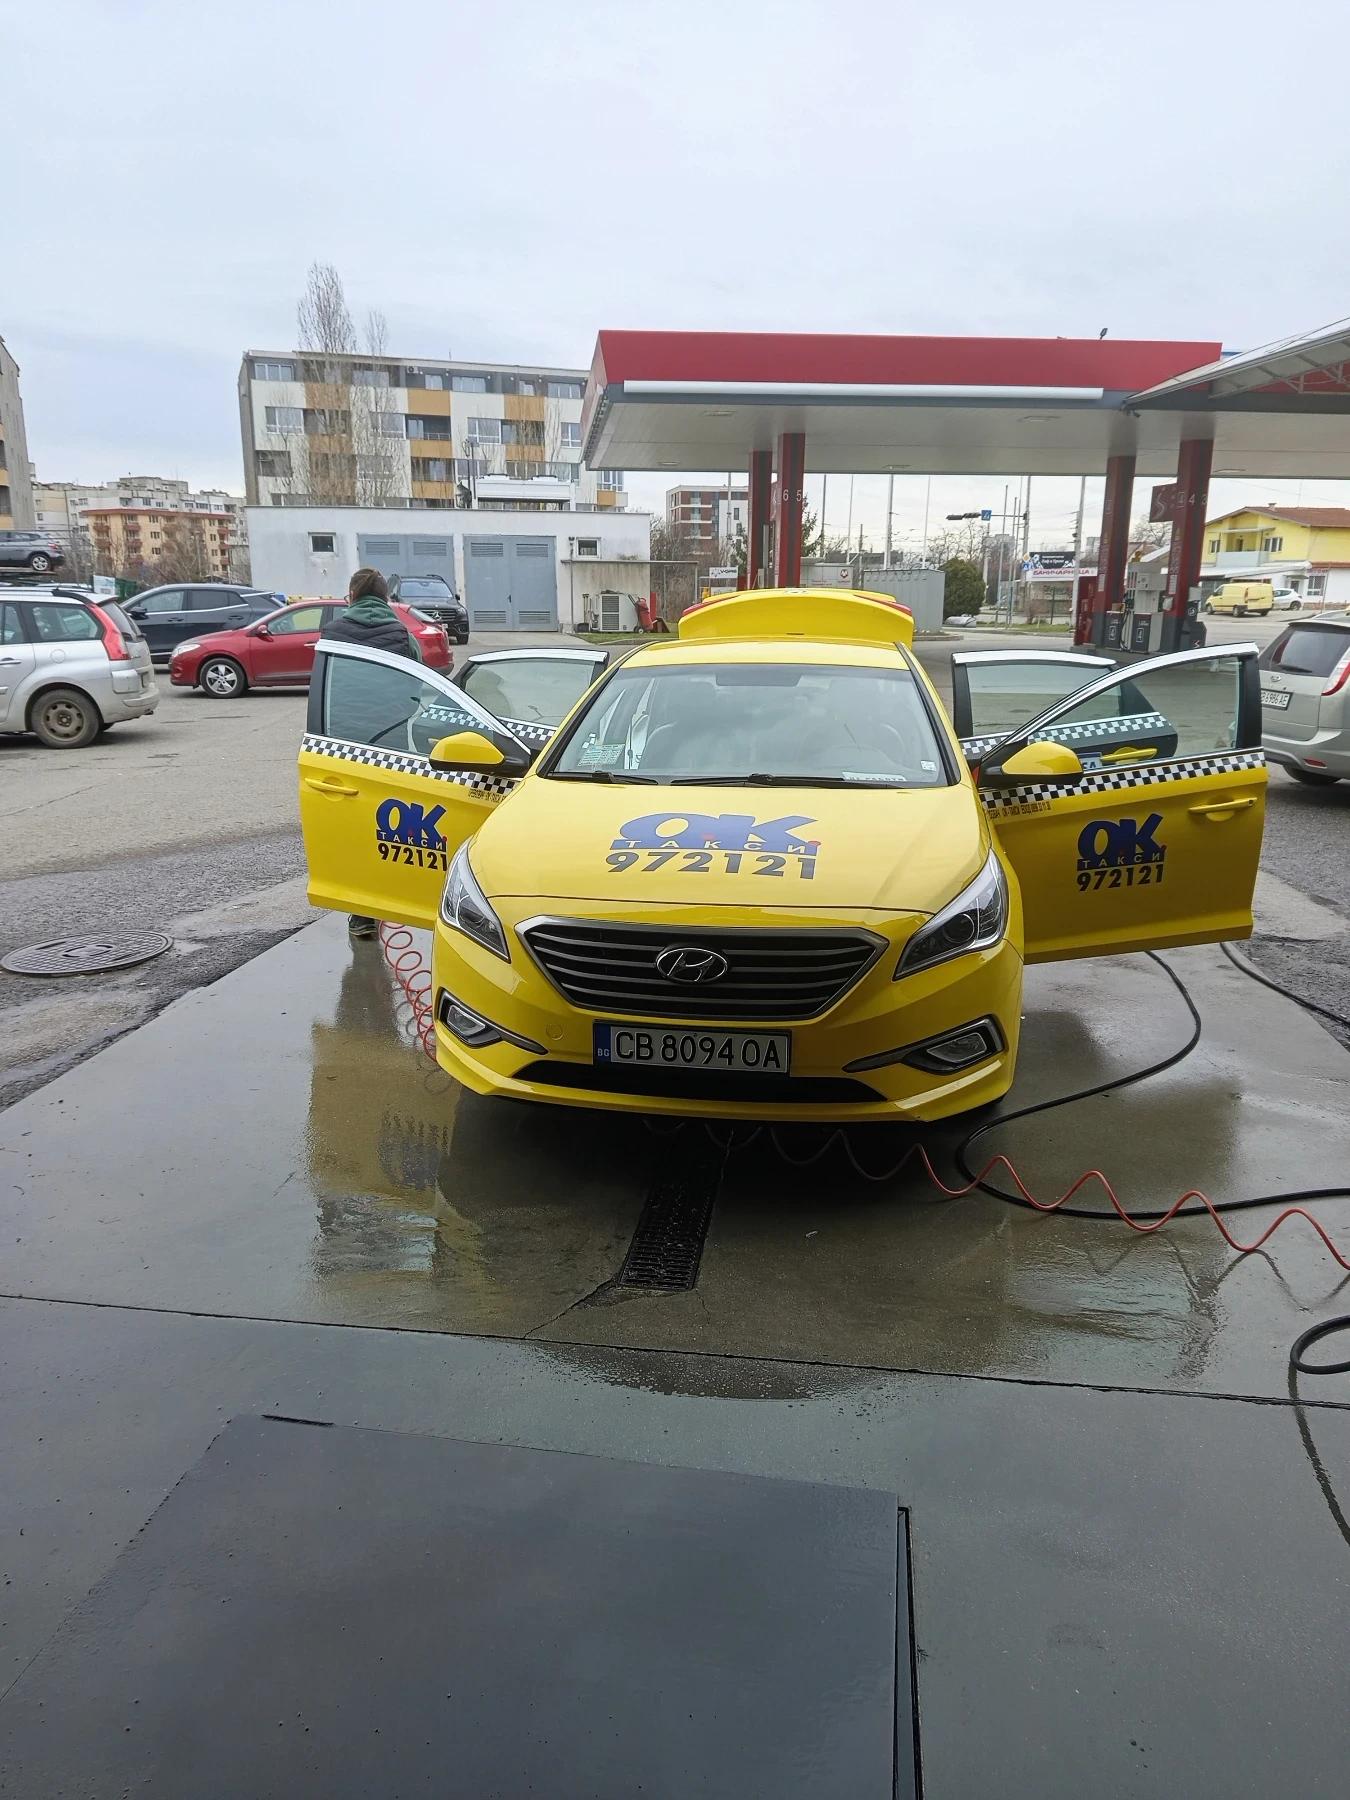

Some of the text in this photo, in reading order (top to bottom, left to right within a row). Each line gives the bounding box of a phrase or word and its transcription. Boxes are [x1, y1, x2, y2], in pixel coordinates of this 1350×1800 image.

[783, 489, 789, 501] 6
[796, 490, 802, 501] 5
[1188, 494, 1196, 505] 4
[1201, 494, 1207, 506] 3
[380, 831, 443, 850] ТАКСИ
[625, 839, 806, 854] ТАКСИ
[378, 842, 448, 872] 972121
[1083, 852, 1161, 869] ТАКСИ
[605, 851, 816, 880] 972121
[1076, 864, 1164, 892] 972121
[597, 1047, 610, 1058] BG
[615, 1031, 781, 1069] CB 8094 OA
